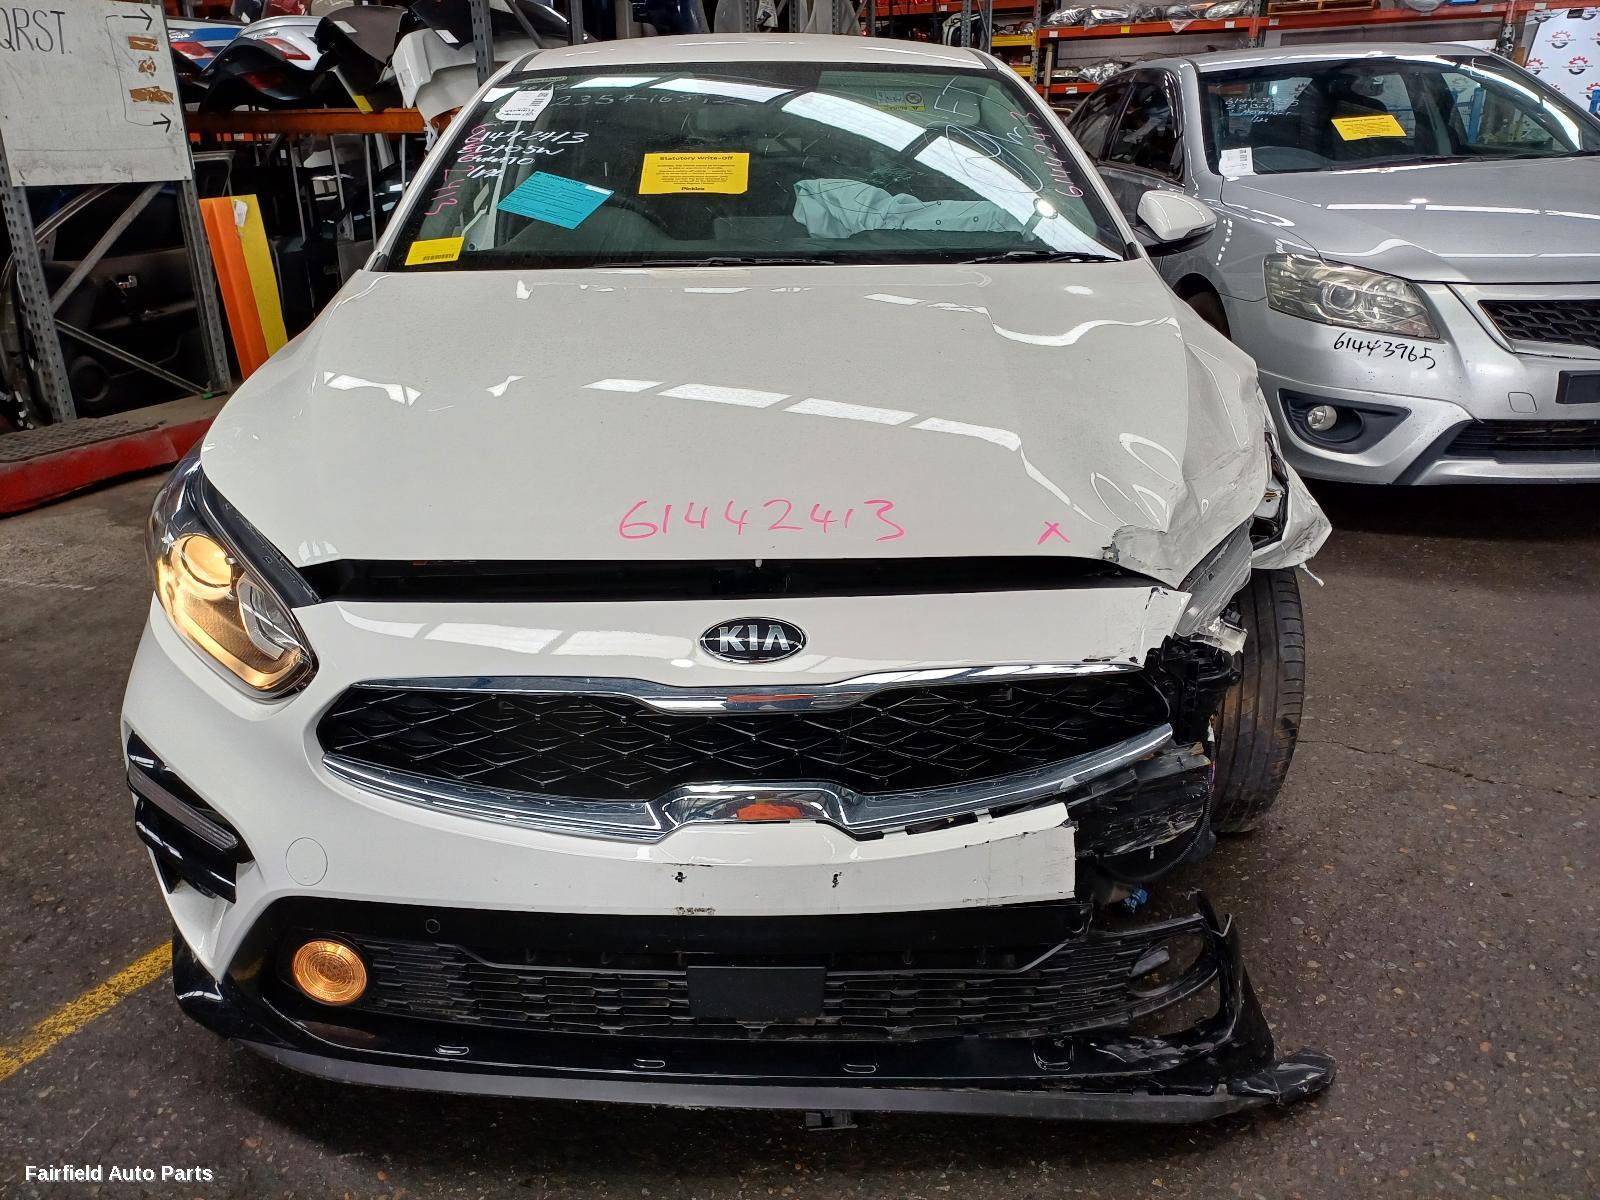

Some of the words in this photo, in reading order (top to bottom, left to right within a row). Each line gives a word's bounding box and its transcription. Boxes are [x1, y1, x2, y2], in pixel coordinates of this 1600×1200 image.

[1333, 331, 1436, 370] 61443965
[619, 499, 905, 540] 61442413
[718, 624, 791, 652] KIA
